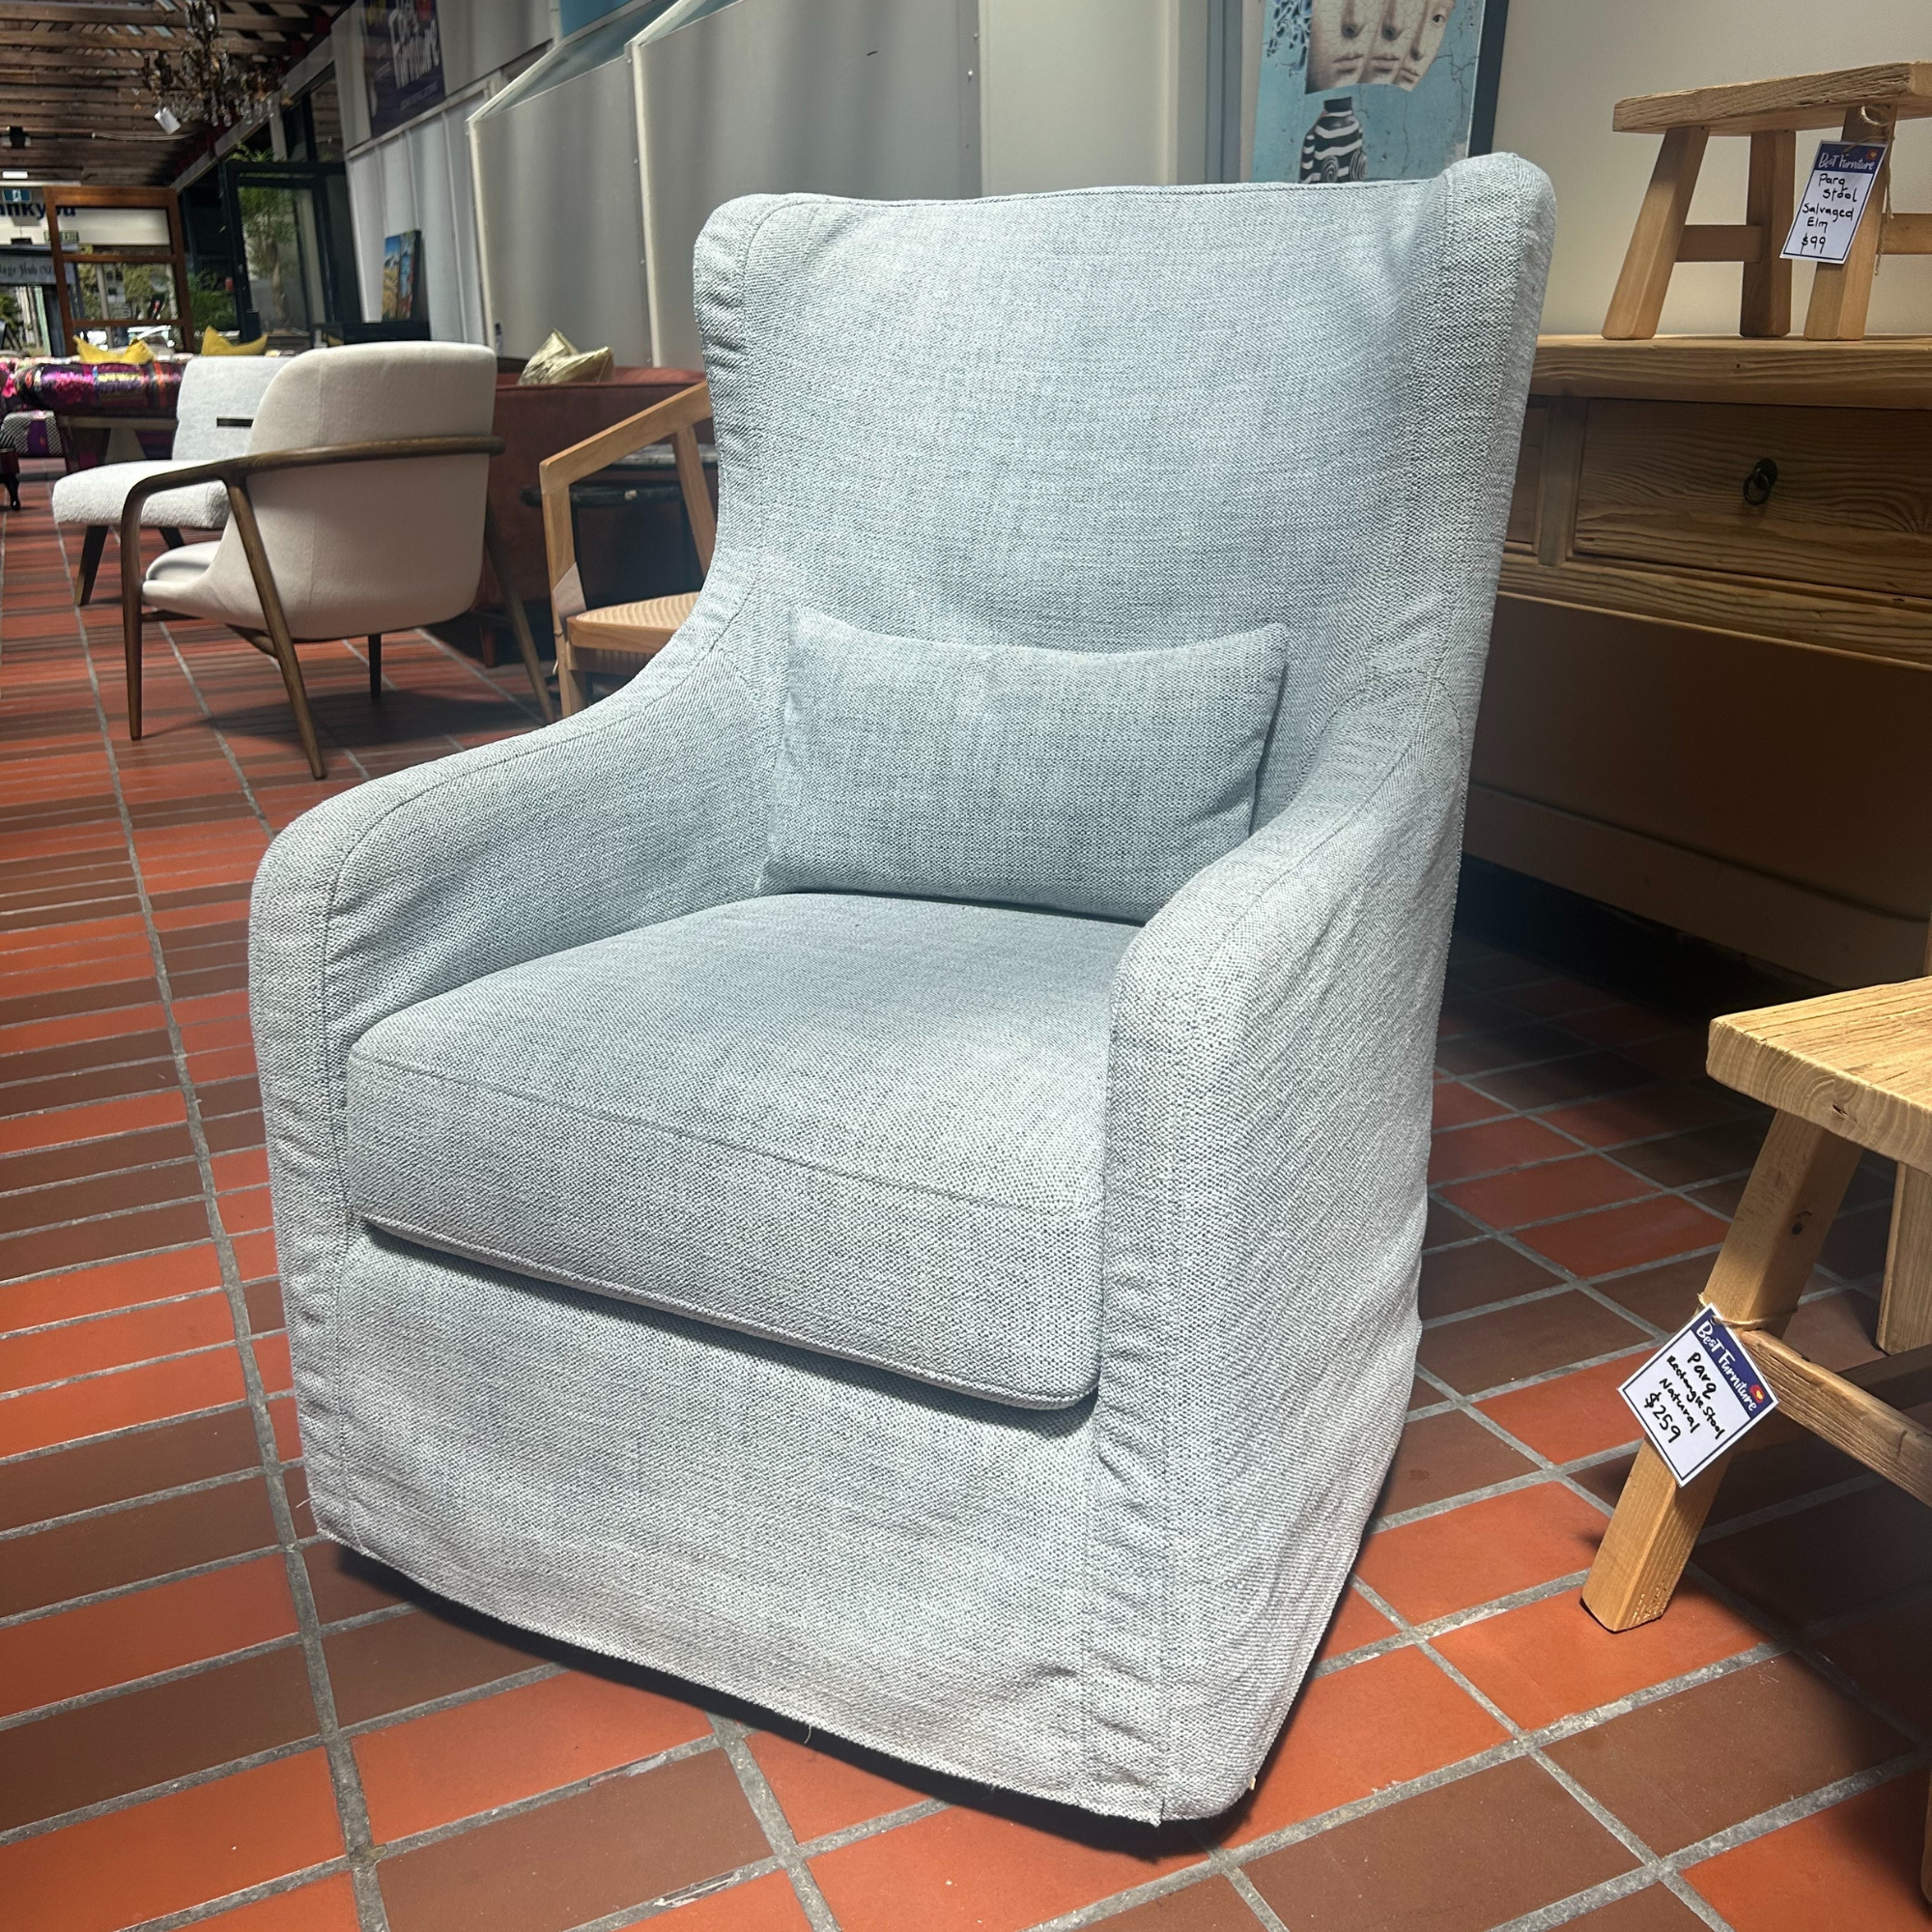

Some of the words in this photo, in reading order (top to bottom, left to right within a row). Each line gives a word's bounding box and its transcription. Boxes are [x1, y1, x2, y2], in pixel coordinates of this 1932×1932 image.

[1839, 154, 1875, 170] Furniture
[1803, 203, 1854, 222] Salvaged
[1806, 216, 1829, 234] Elm
[1801, 234, 1826, 254] $99
[1718, 1349, 1757, 1411] Furniture
[1643, 1391, 1682, 1444] $259
[1659, 1378, 1701, 1434] Natural
[1703, 1406, 1725, 1440] Stool
